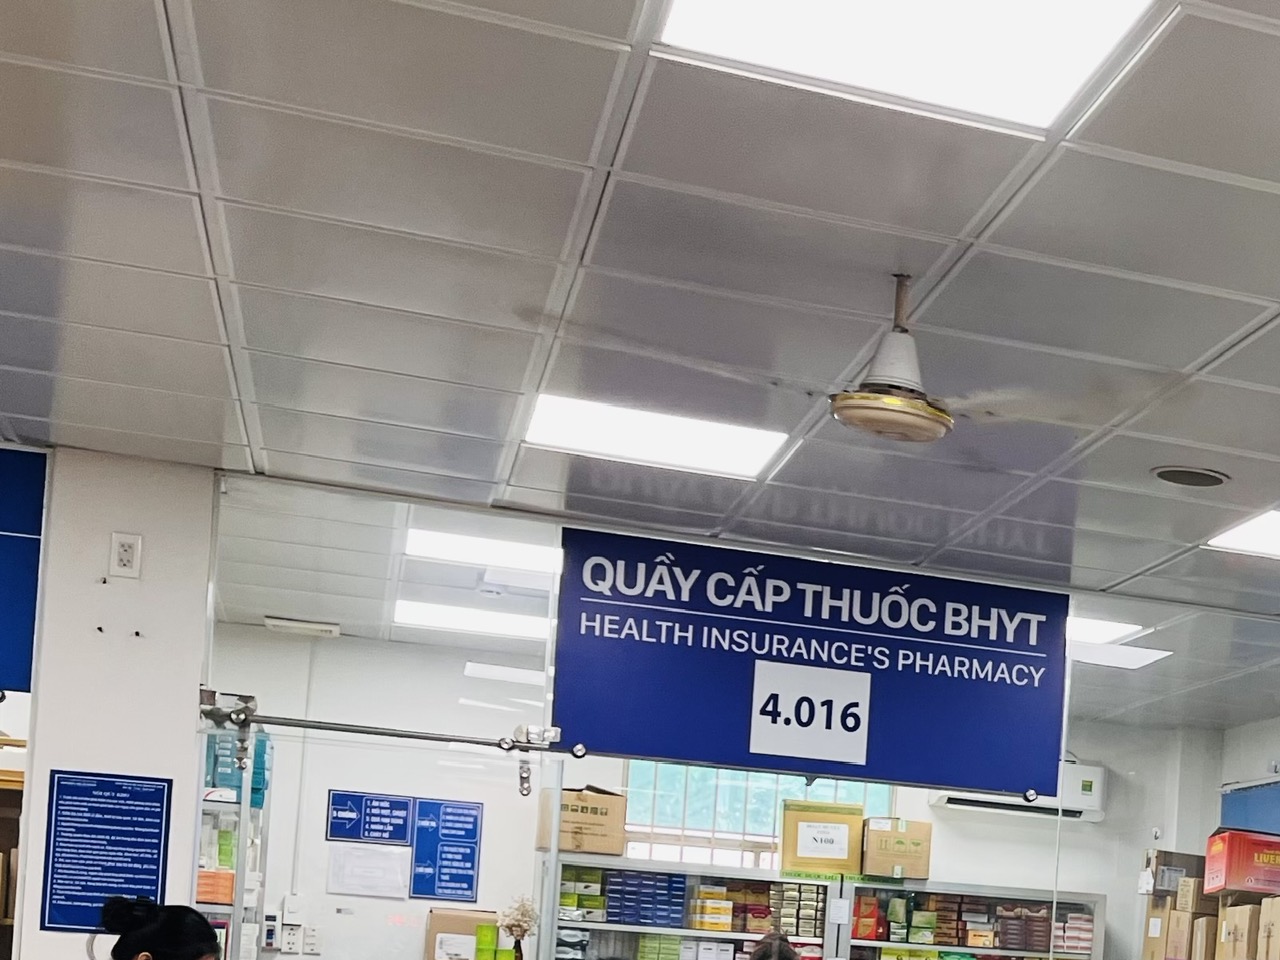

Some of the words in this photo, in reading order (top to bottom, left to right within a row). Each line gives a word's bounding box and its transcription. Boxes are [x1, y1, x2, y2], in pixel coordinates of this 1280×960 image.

[582, 552, 700, 601] QUẦY
[706, 565, 790, 612] CẤP
[797, 583, 937, 632] THUỐC
[944, 601, 1046, 645] BHYT
[580, 613, 693, 646] HEALTH
[702, 626, 889, 669] INSURANCE'S
[898, 650, 1045, 687] PHARMACY
[760, 692, 861, 732] 4.016
